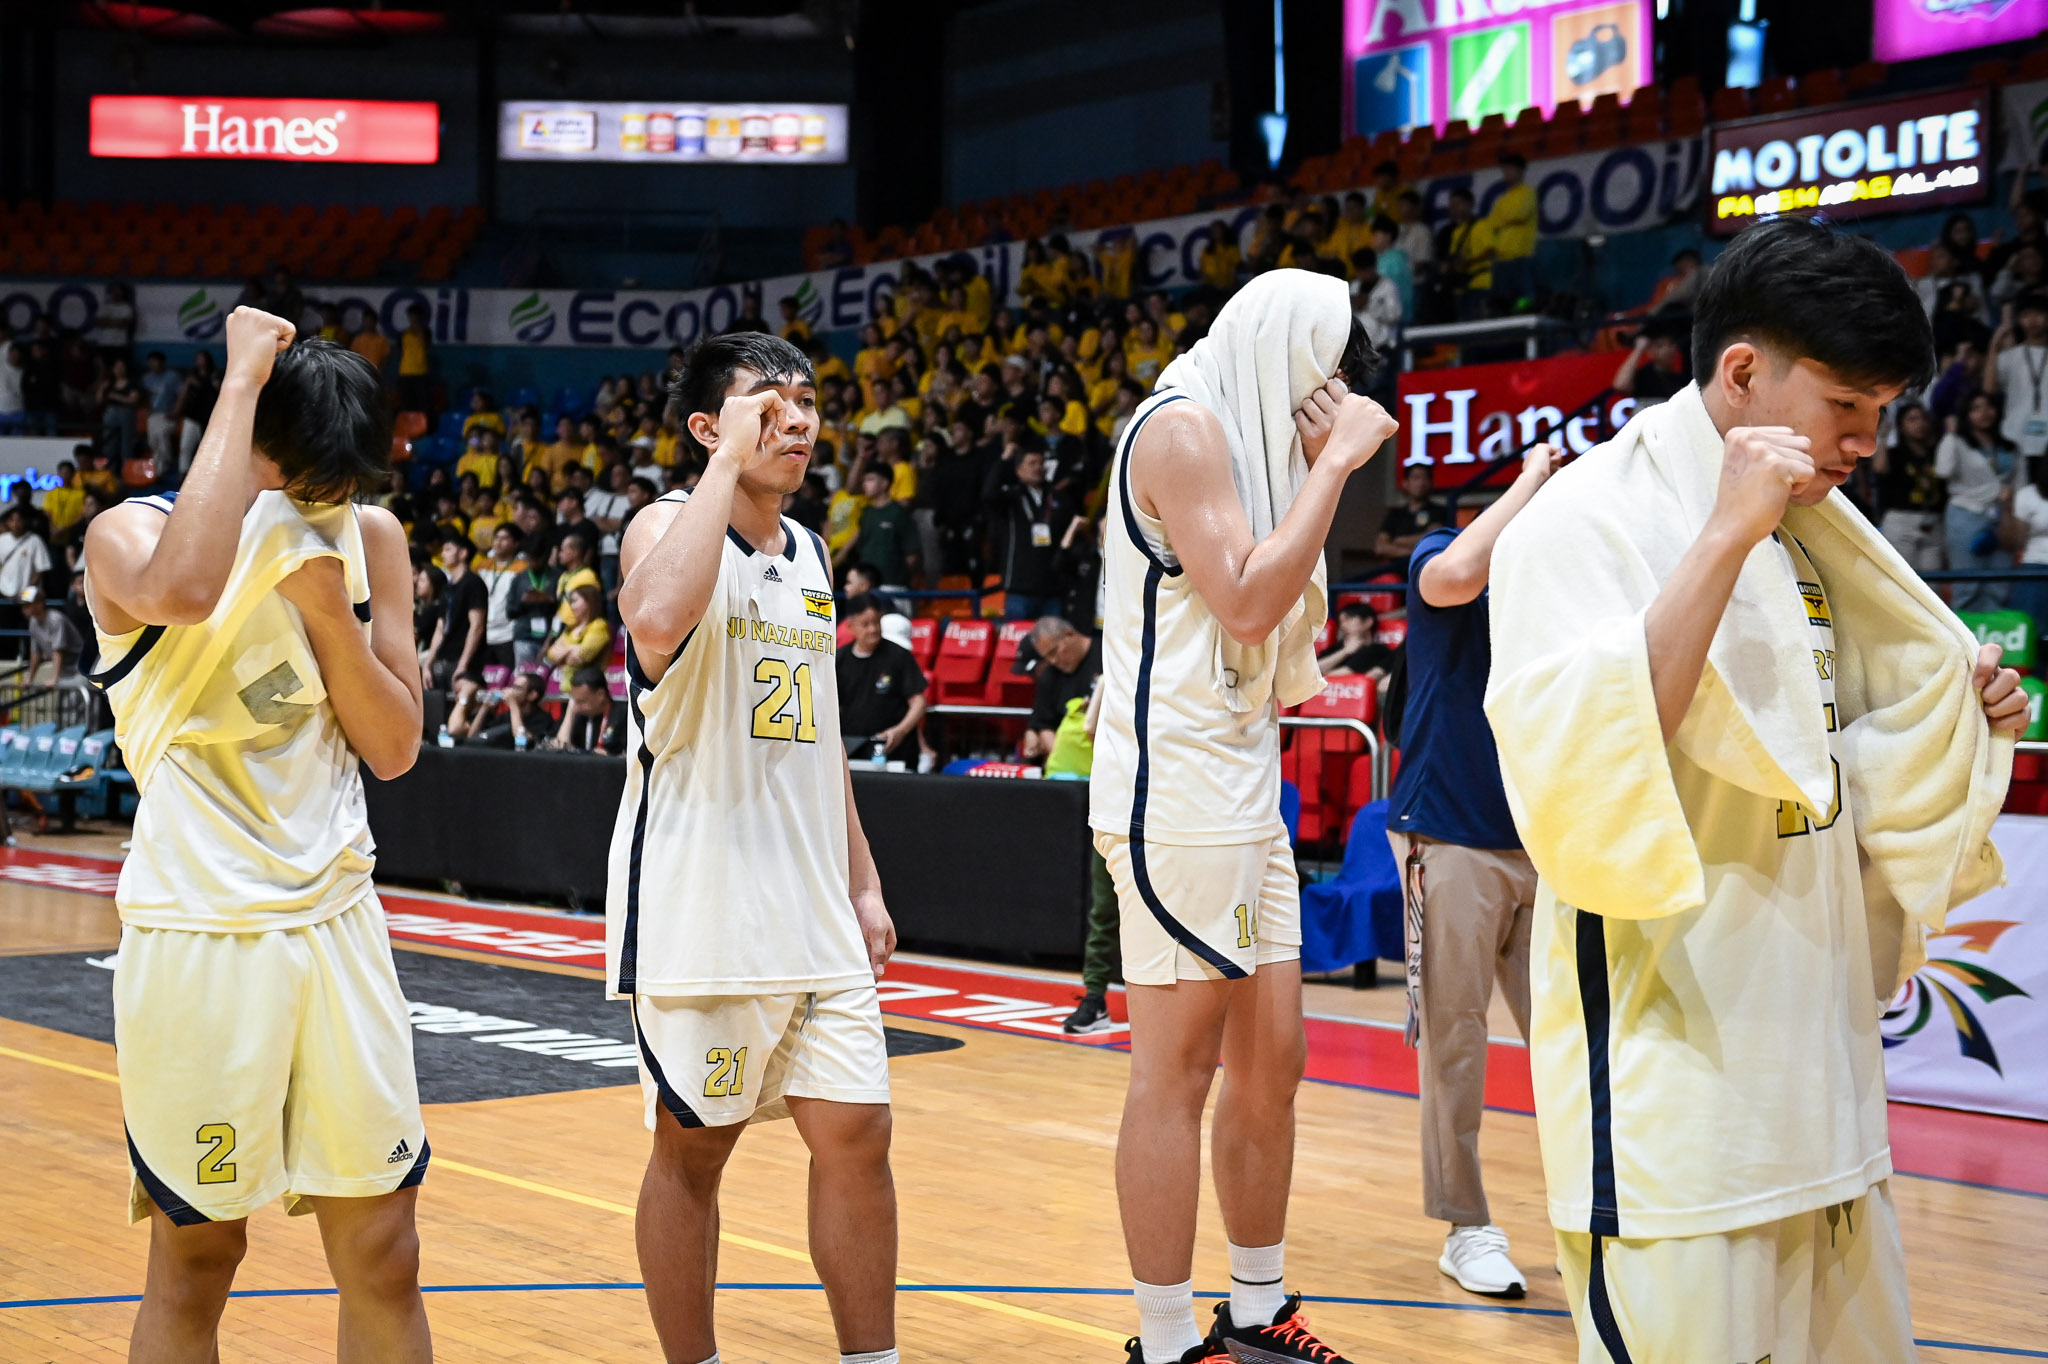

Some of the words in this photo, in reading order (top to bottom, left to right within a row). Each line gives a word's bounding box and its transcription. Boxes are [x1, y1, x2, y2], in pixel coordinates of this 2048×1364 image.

[180, 104, 339, 156] Hanes
[1711, 109, 1980, 195] MOTOLITE
[763, 574, 783, 583] adidas
[802, 589, 832, 601] BOYSEN
[750, 657, 816, 744] 21
[703, 1047, 748, 1097] 21
[196, 1122, 237, 1185] 2
[388, 1153, 413, 1163] adidas
